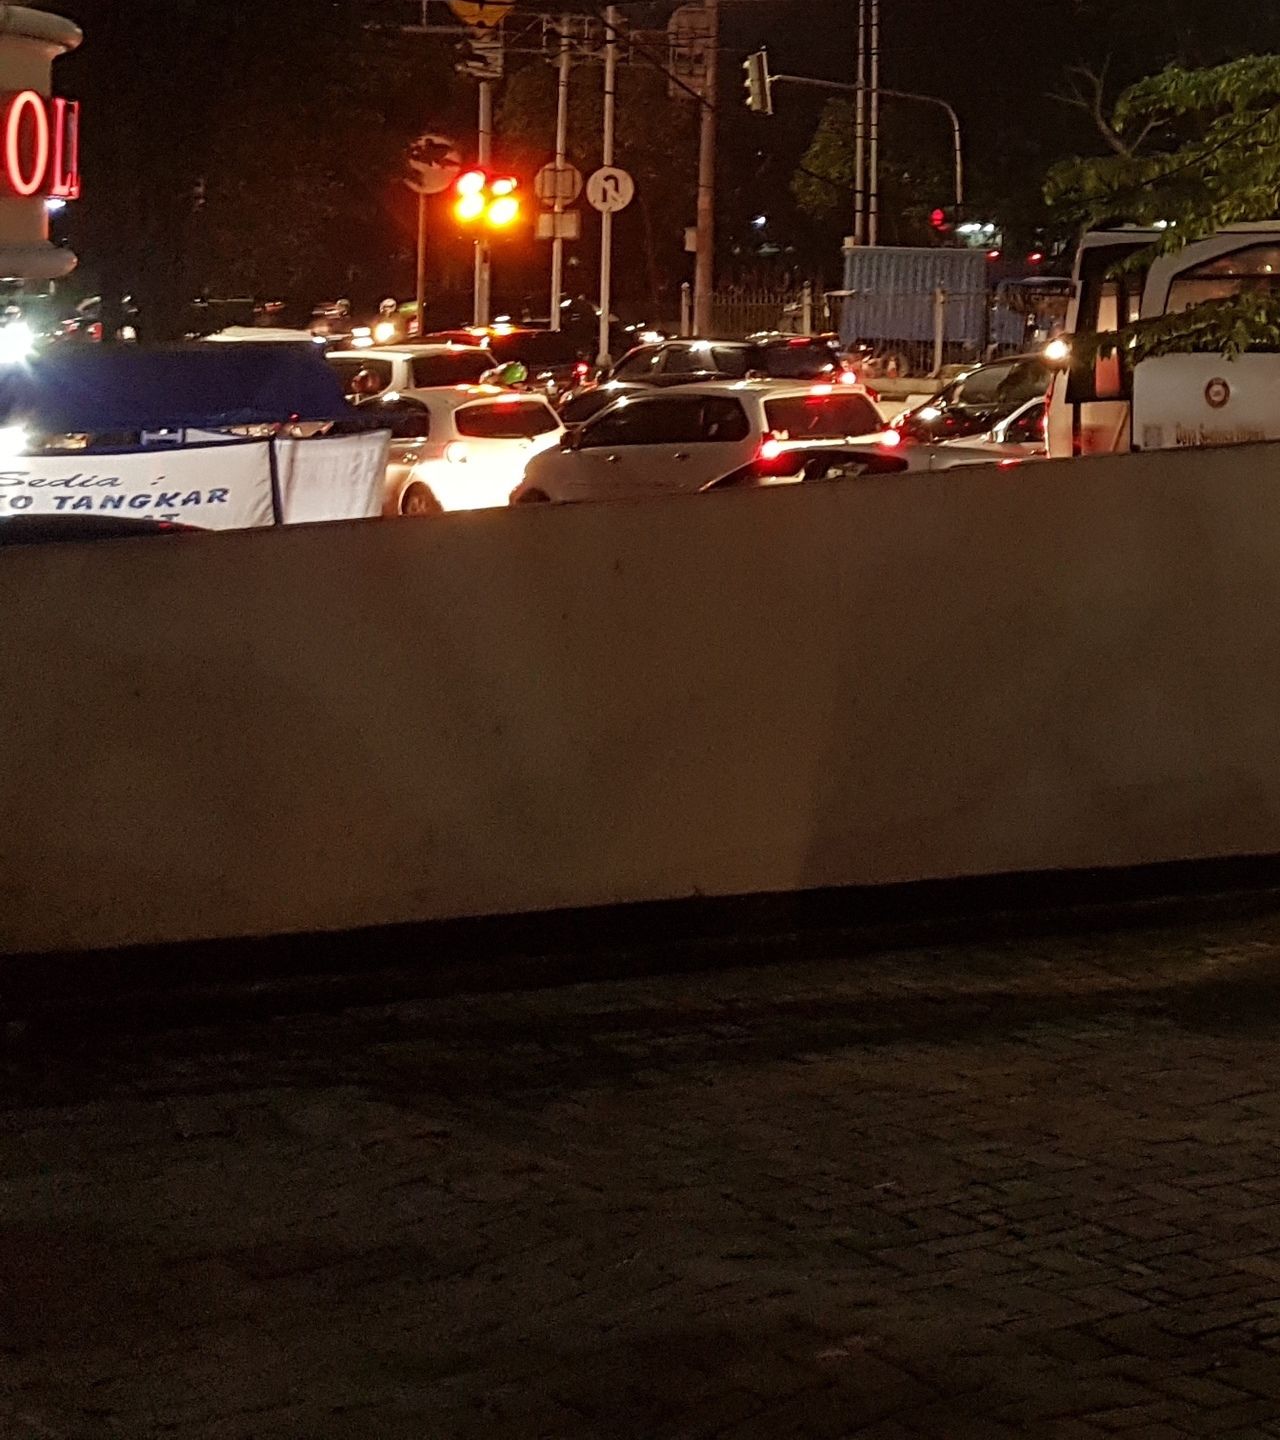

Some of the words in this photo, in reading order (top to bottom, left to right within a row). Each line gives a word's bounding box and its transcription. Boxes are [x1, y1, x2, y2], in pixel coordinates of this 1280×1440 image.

[0, 471, 123, 488] Sedia
[0, 494, 33, 509] O
[53, 488, 230, 510] TANGKAR
